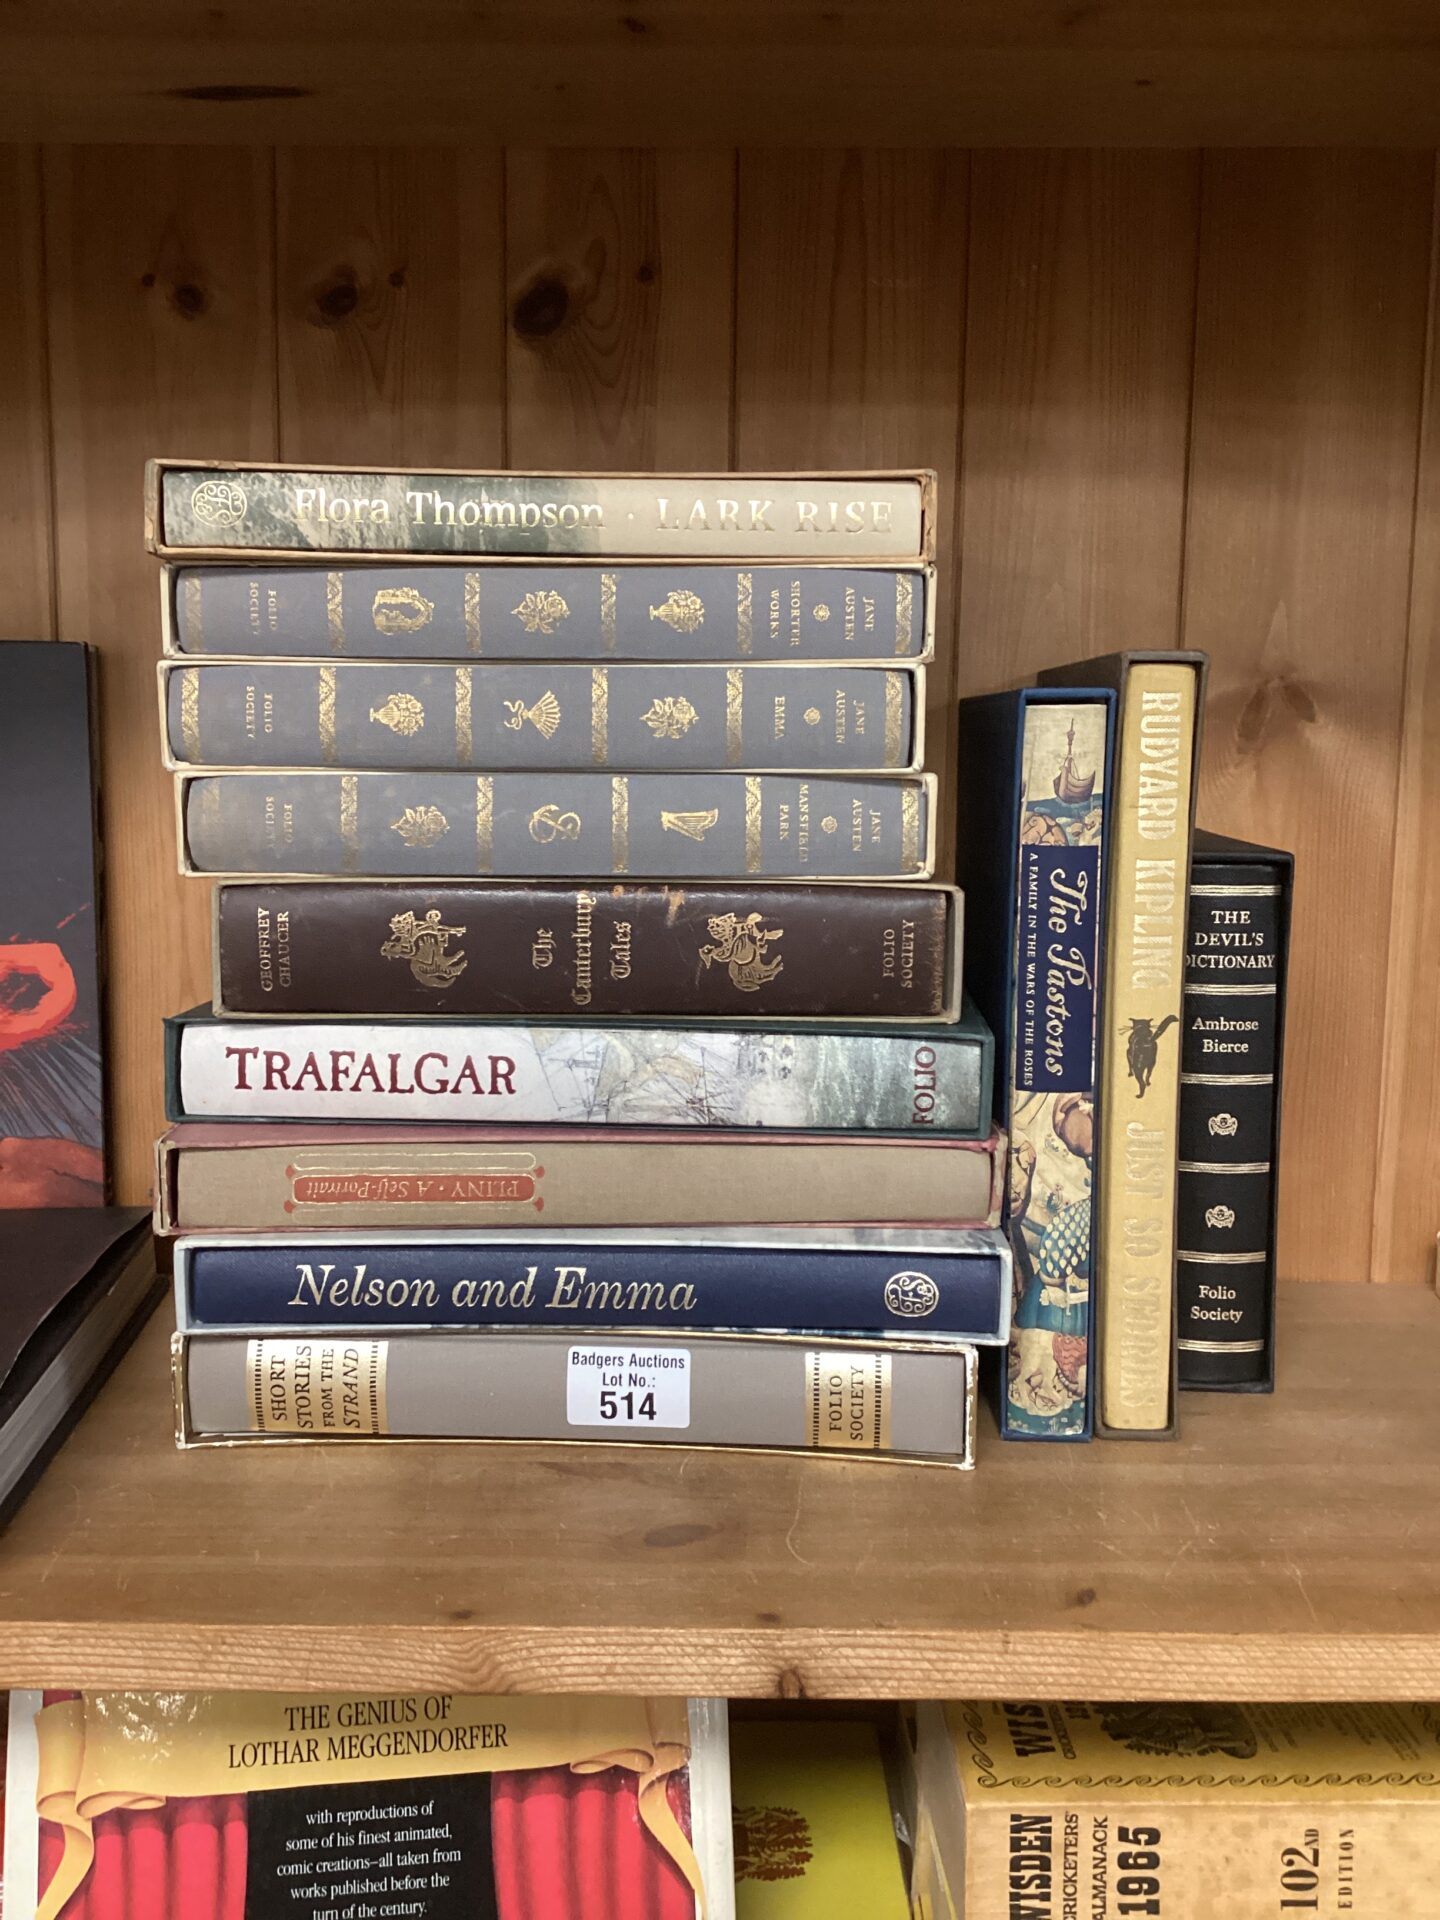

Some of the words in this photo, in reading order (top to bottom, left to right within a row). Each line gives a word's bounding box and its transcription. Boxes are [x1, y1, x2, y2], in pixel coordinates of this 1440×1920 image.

[294, 488, 391, 524] Flora
[406, 490, 606, 534] Thompson
[656, 498, 776, 532] LARK
[795, 501, 892, 533] RISE
[268, 589, 277, 631] FOLIO
[769, 589, 780, 639] WORKS
[789, 580, 800, 646] SHORTER
[844, 586, 855, 640] AUSTEN
[862, 596, 875, 631] JANE
[245, 685, 256, 739] SOCIETY
[263, 692, 273, 734] FOLIO
[774, 696, 786, 740] EMMA
[835, 689, 846, 744] AUSTEN
[853, 700, 865, 734] JANE
[1137, 690, 1182, 841] RUDYARD
[283, 803, 293, 844] FOLIO
[779, 804, 790, 840] PARK
[852, 798, 863, 851] AUSTEN
[868, 809, 881, 843] JANE
[1028, 852, 1039, 862] A
[1027, 865, 1039, 911] FAMILY
[1048, 867, 1089, 934] The
[1026, 914, 1037, 929] IN
[1131, 858, 1176, 990] KIPLING
[1211, 911, 1251, 924] THE
[257, 907, 273, 992] GEOFFREY
[276, 911, 292, 988] CHAUCER
[531, 927, 558, 970] The
[570, 892, 598, 1006] Canterbury
[609, 920, 632, 980] Tales
[882, 928, 896, 978] FOLIO
[901, 919, 915, 989] SOCIETY
[1026, 932, 1037, 958] THE
[1195, 932, 1264, 947] DEVIL'S
[1025, 962, 1036, 996] WARS
[1025, 998, 1035, 1016] OF
[1044, 942, 1092, 1077] Pastons
[1192, 1017, 1259, 1031] Ambrose
[1024, 1019, 1035, 1045] THE
[1202, 1039, 1249, 1053] Bierce
[225, 1046, 517, 1096] TRAFALGAR
[911, 1046, 937, 1125] FOLIO
[1023, 1049, 1034, 1087] ROSES
[1124, 1121, 1166, 1200] JUST
[306, 1178, 410, 1199] Self-Portrait
[416, 1180, 435, 1195] A
[450, 1180, 520, 1198] PLINY
[1124, 1217, 1163, 1258] SO
[288, 1263, 440, 1307] Nelson
[451, 1267, 539, 1308] and
[544, 1266, 698, 1311] Emma
[1198, 1285, 1236, 1300] Folio
[1190, 1306, 1243, 1323] Society
[572, 1351, 624, 1370] Badgers
[629, 1353, 686, 1369] Auctions
[1119, 1275, 1162, 1408] STORIES
[320, 1348, 335, 1382] THE
[602, 1372, 623, 1387] Lot
[628, 1373, 656, 1388] No.:
[270, 1355, 288, 1421] SHORT
[294, 1345, 314, 1429] STORIES
[320, 1386, 336, 1428] FROM
[342, 1347, 361, 1429] STRAND
[600, 1391, 657, 1421] 514
[828, 1374, 843, 1432] FOLIO
[850, 1365, 864, 1441] SOCIETY
[284, 1705, 330, 1731] THE
[337, 1698, 417, 1728] GENIUS
[424, 1695, 453, 1721] OF
[228, 1738, 319, 1769] LOTHAR
[327, 1723, 508, 1761] MEGGENDORFER
[306, 1809, 333, 1825] with
[336, 1804, 418, 1826] reproductions
[421, 1800, 435, 1816] of
[285, 1837, 318, 1852] some
[321, 1832, 335, 1849] of
[337, 1832, 355, 1847] his
[358, 1829, 391, 1845] finest
[394, 1823, 452, 1843] animated,
[276, 1860, 313, 1877] comic
[396, 1849, 429, 1867] taken
[432, 1847, 462, 1864] from
[1009, 1813, 1053, 1920] WISDEN
[1091, 1815, 1109, 1920] ALMANACK
[1116, 1825, 1162, 1916] 1965
[1337, 1828, 1355, 1910] EDITION
[290, 1882, 328, 1900] works
[330, 1875, 388, 1900] published
[390, 1873, 428, 1892] before
[431, 1871, 450, 1888] the
[342, 1903, 356, 1919] of
[358, 1902, 377, 1918] the
[379, 1900, 428, 1918] century.
